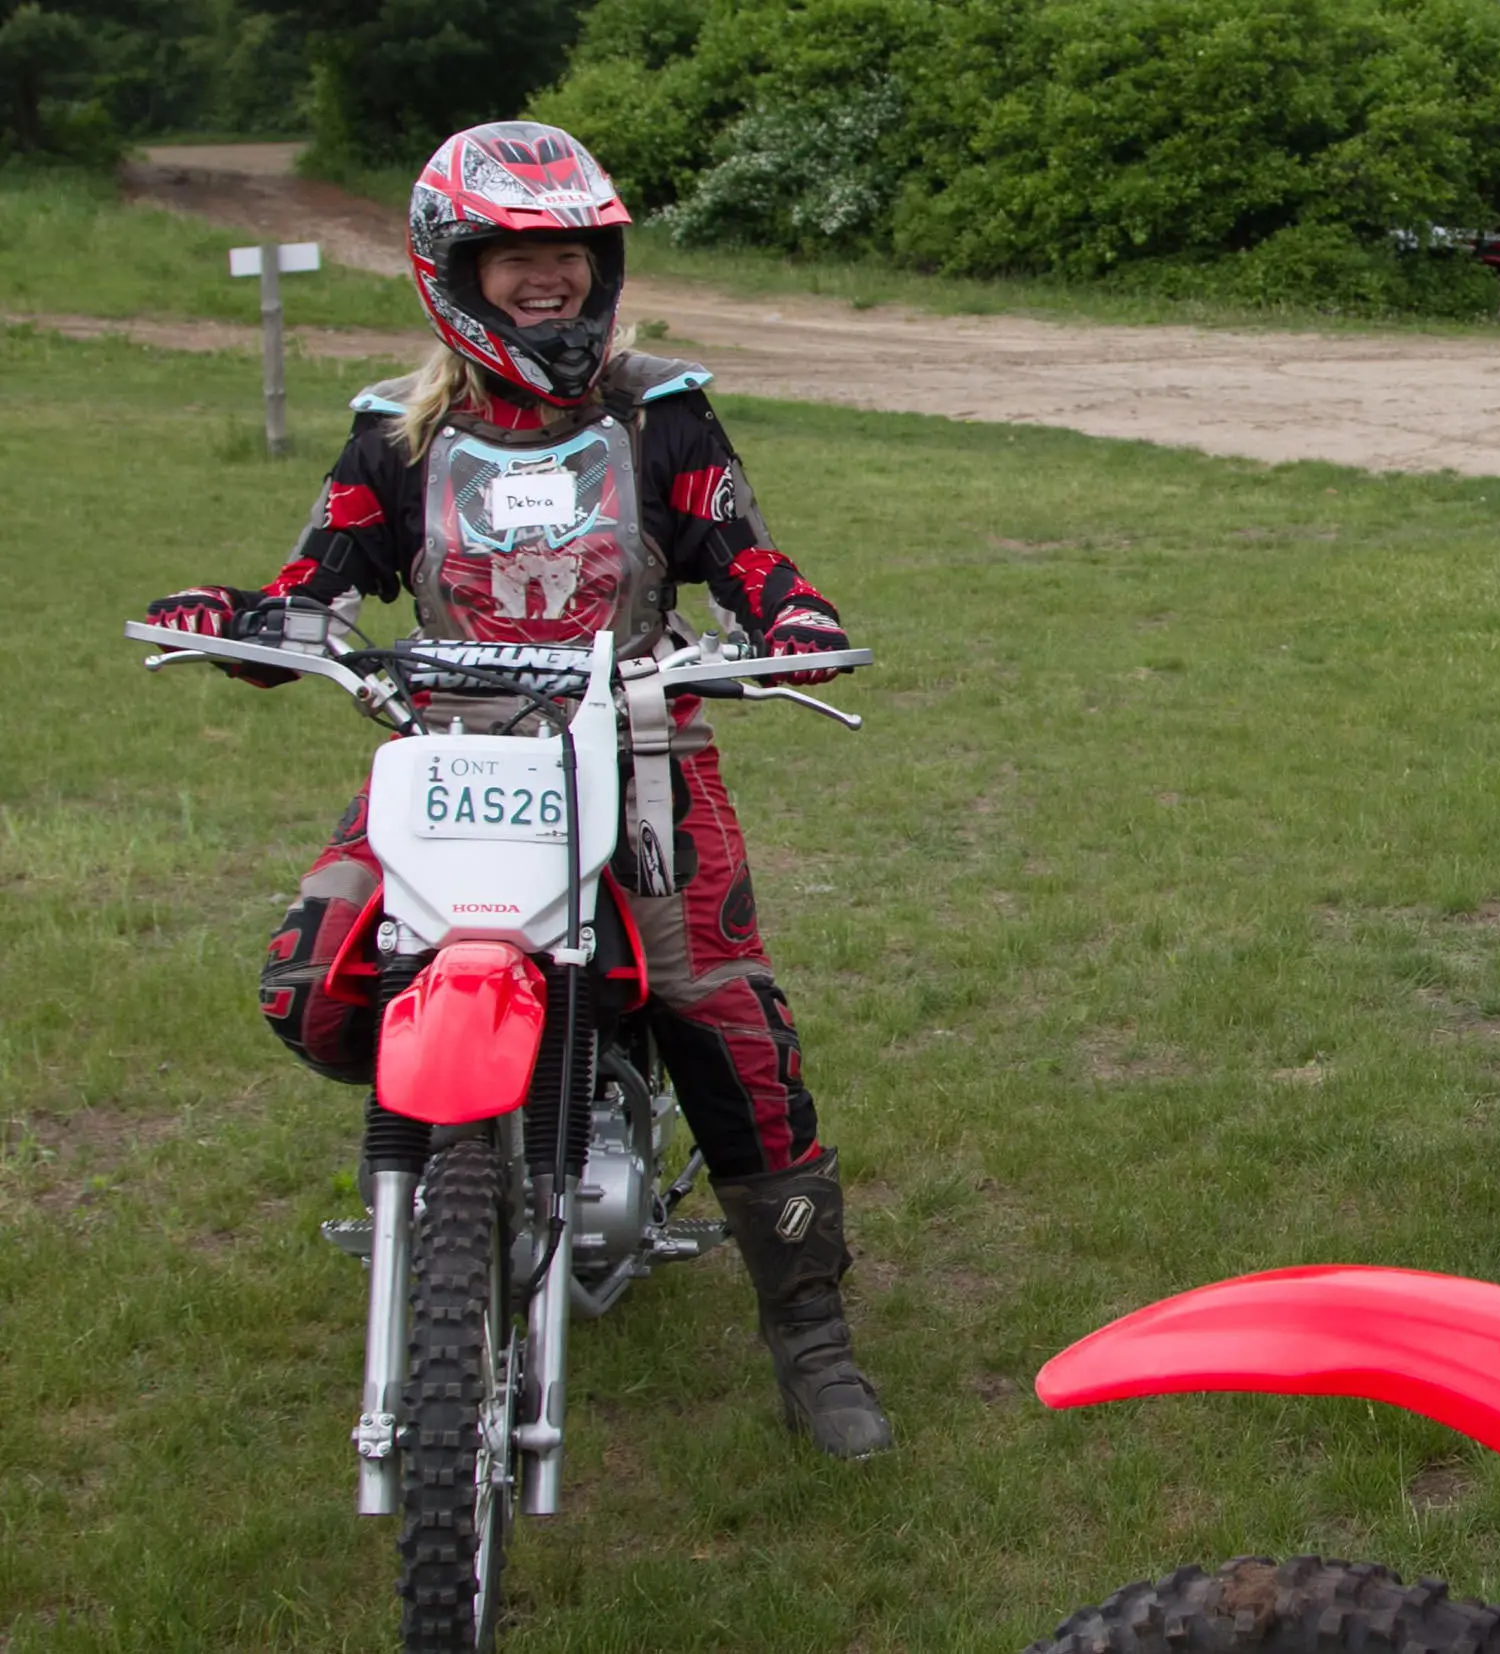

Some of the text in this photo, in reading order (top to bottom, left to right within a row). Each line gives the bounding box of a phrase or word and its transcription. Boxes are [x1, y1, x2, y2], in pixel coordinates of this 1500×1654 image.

[544, 194, 588, 205] BELL
[507, 495, 554, 511] Debra
[426, 785, 563, 826] 6AS26
[452, 902, 521, 914] HONDA
